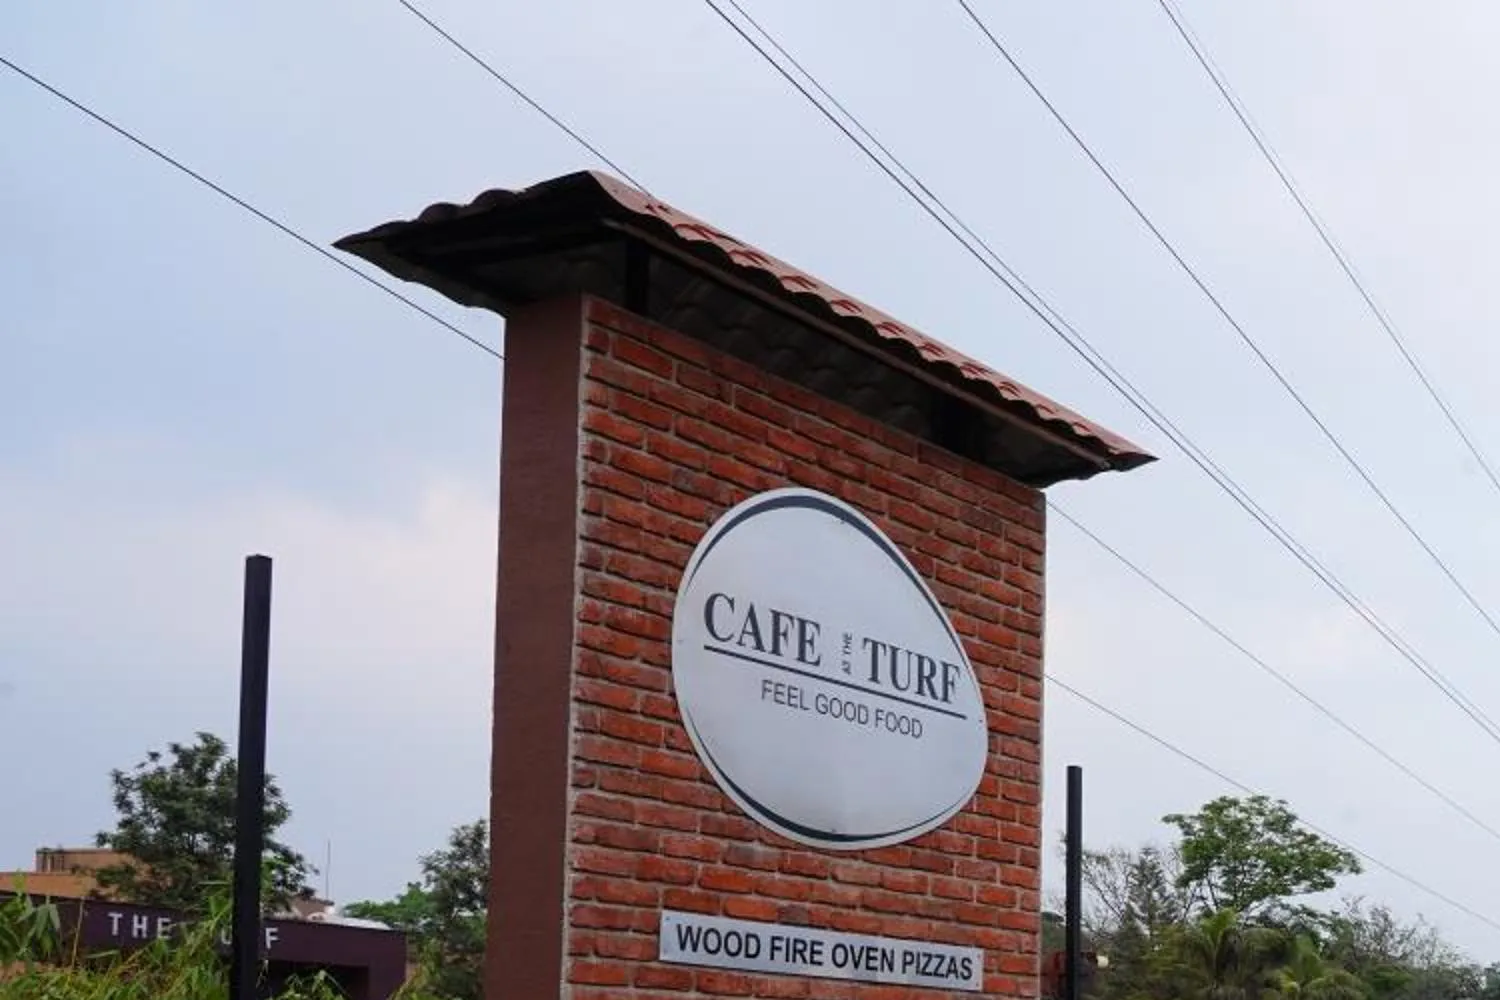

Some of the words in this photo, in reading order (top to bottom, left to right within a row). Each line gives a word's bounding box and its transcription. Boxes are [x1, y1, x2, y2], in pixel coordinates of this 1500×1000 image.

[703, 591, 822, 667] CAFE
[862, 636, 961, 704] TURF
[760, 678, 810, 711] FEEL
[814, 693, 869, 726] GOOD
[874, 707, 923, 740] FOOD
[108, 912, 172, 940] THE
[676, 922, 761, 960] WOOD
[769, 935, 824, 967] FIRE
[831, 942, 895, 973] OVEN
[901, 950, 973, 981] PIZZAS
